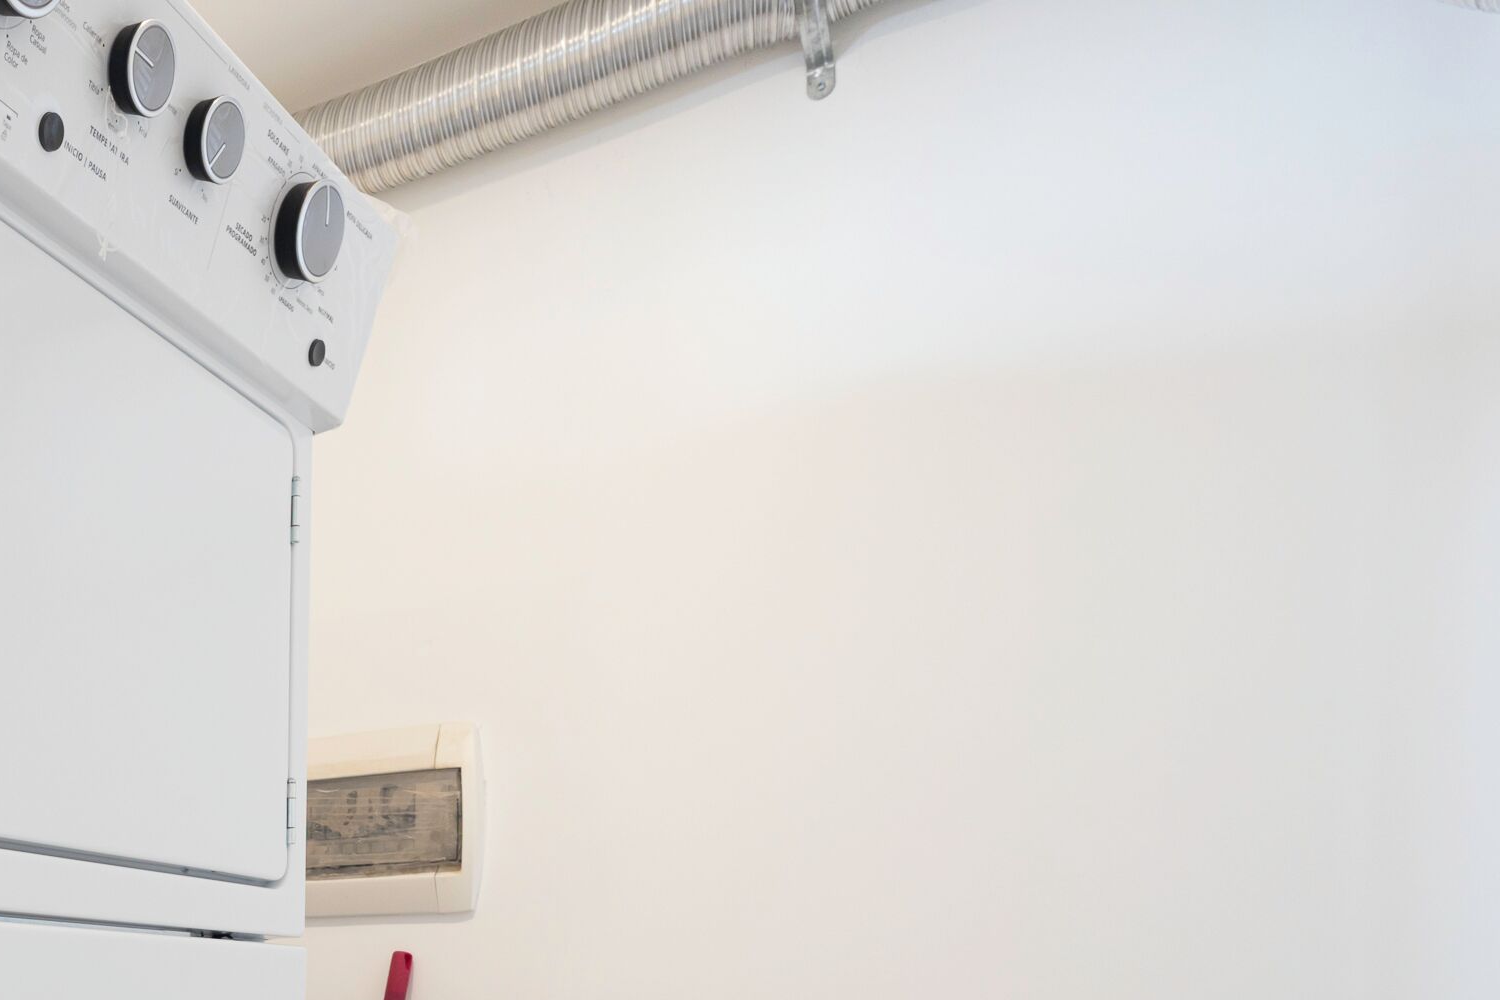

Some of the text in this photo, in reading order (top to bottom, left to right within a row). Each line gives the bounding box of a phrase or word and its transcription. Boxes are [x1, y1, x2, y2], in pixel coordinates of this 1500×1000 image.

[31, 24, 46, 42] Ropa
[4, 52, 18, 68] Color
[6, 40, 20, 58] Ropa
[268, 129, 280, 145] SOLO
[279, 141, 290, 156] AIRE
[63, 140, 83, 163] INICIO
[88, 161, 107, 182] PAUSA
[168, 194, 199, 225] SUAVIZANTE
[225, 224, 257, 257] PROGRAMADO
[235, 222, 253, 242] SECADO
